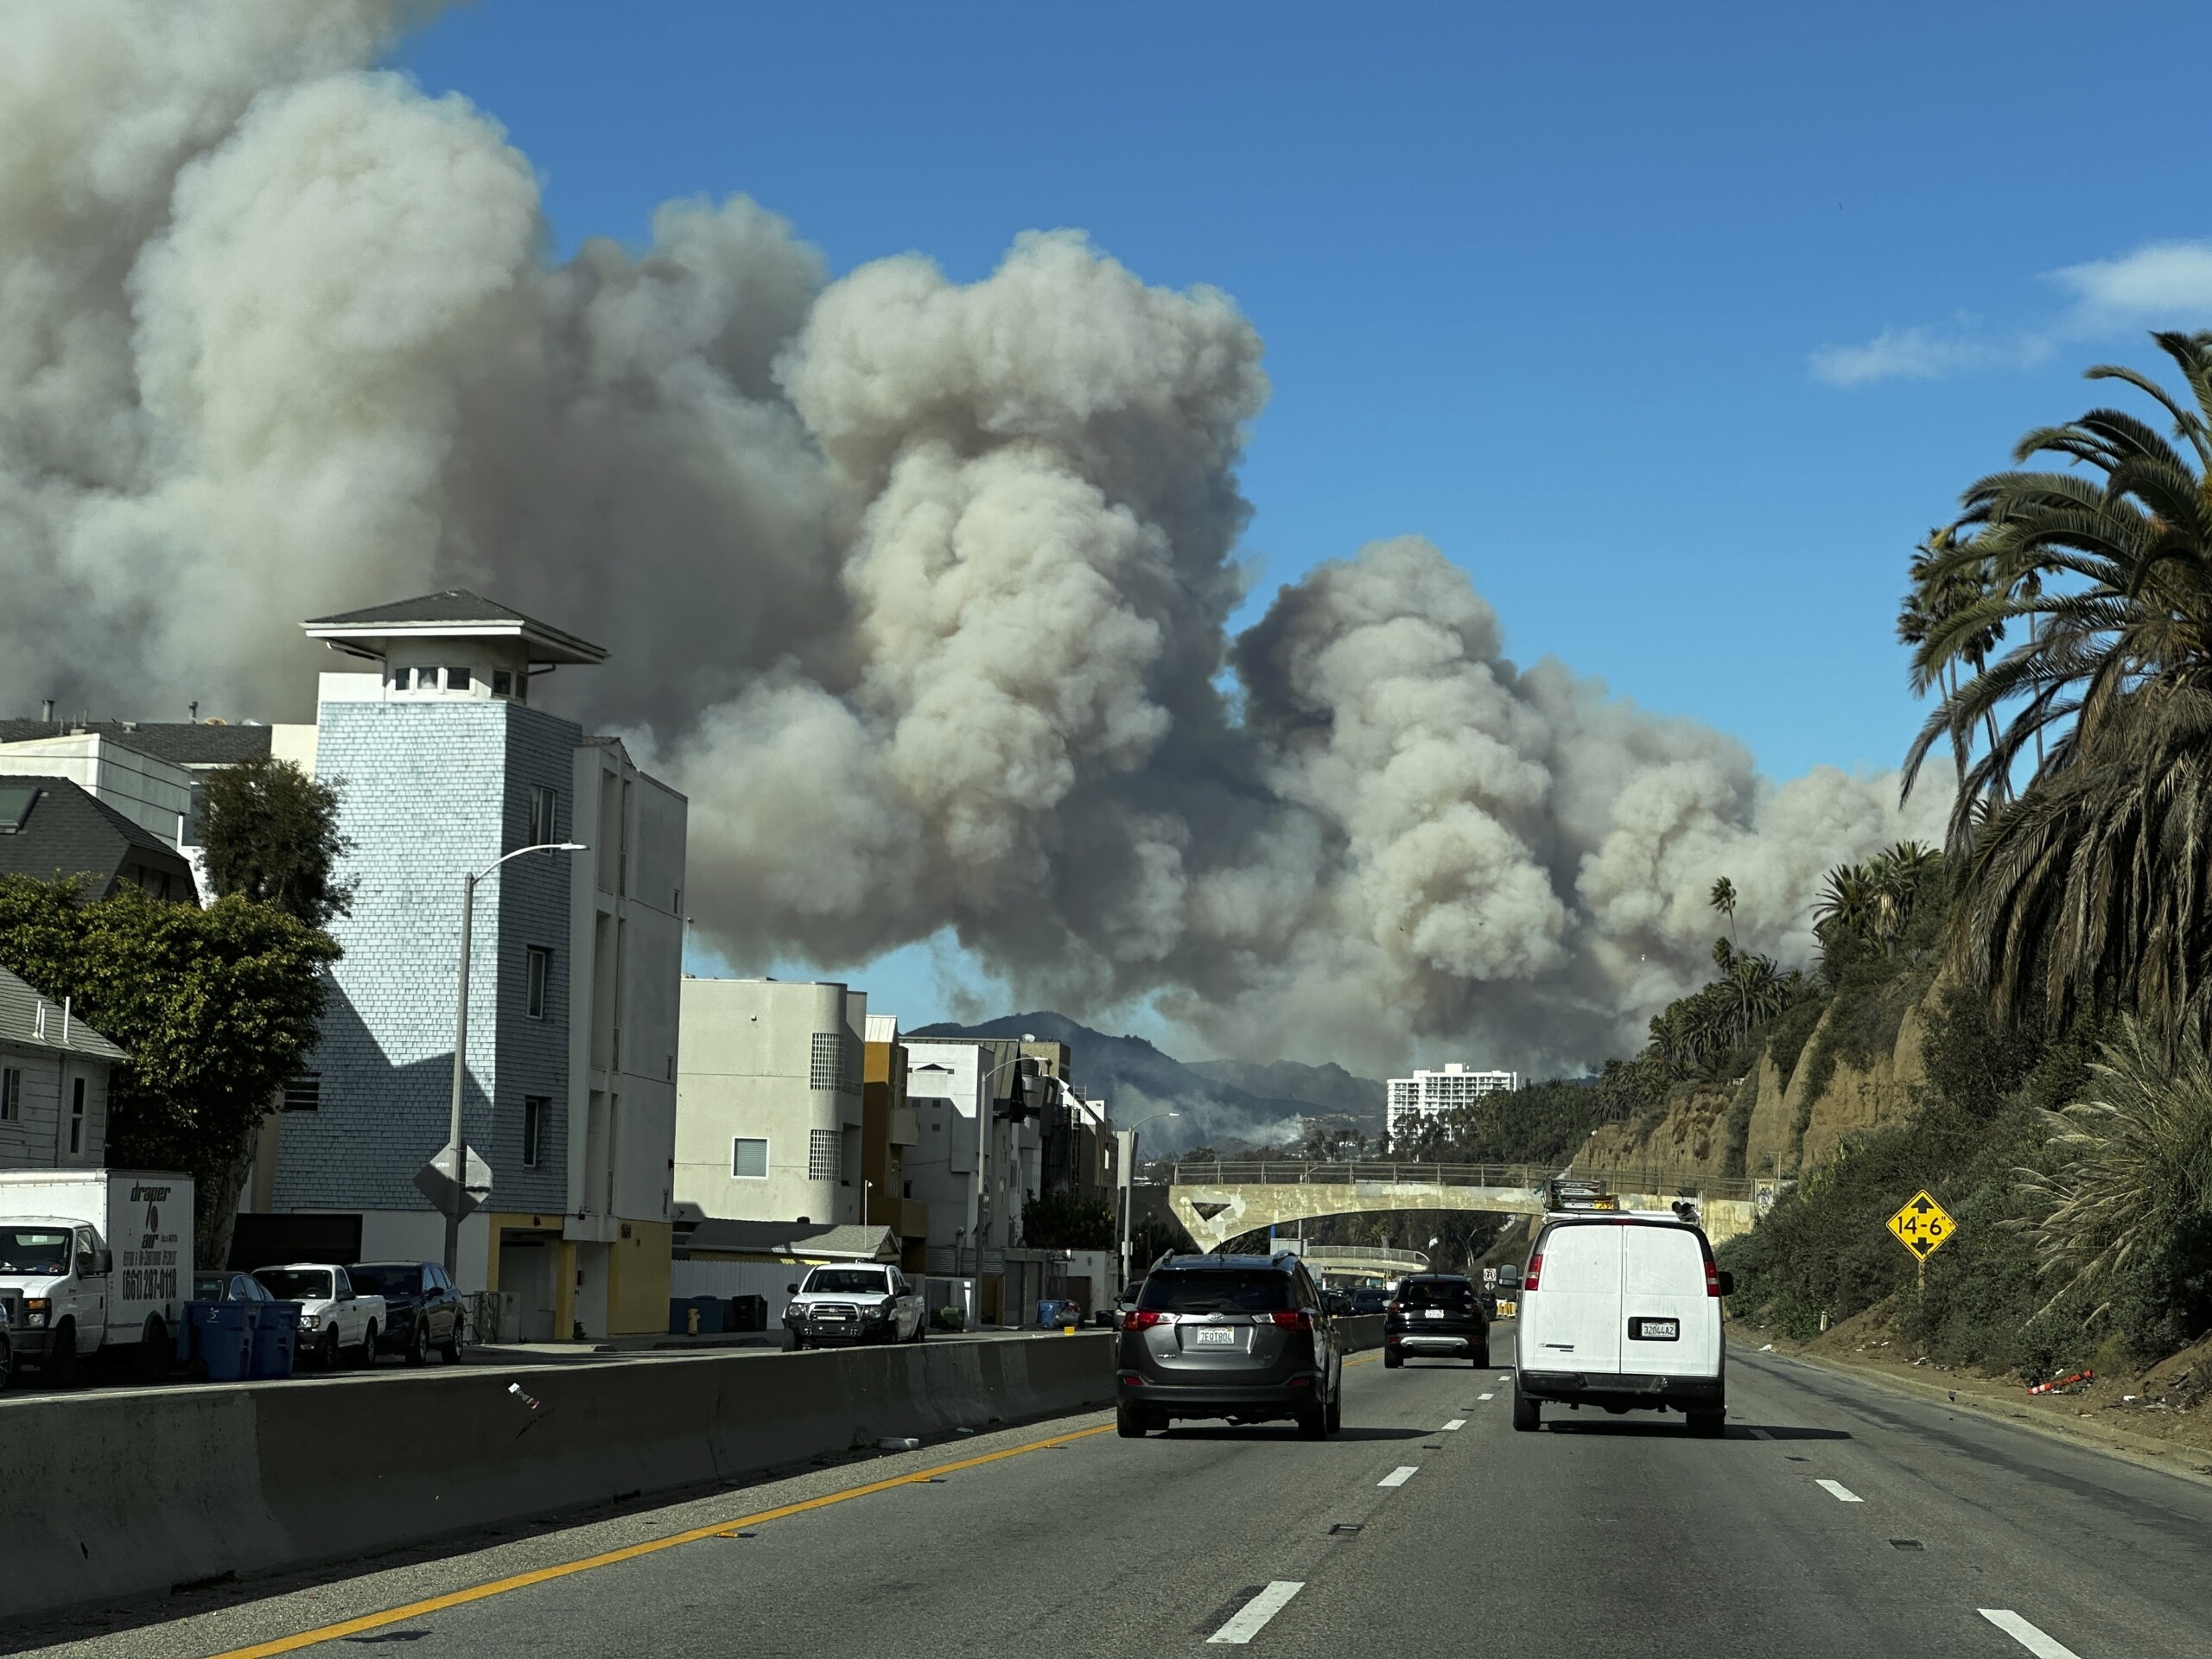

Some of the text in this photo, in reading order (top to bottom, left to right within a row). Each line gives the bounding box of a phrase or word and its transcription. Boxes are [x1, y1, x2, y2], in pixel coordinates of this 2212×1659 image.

[141, 1234, 159, 1249] air
[123, 1268, 177, 1301] (661) 287-0118
